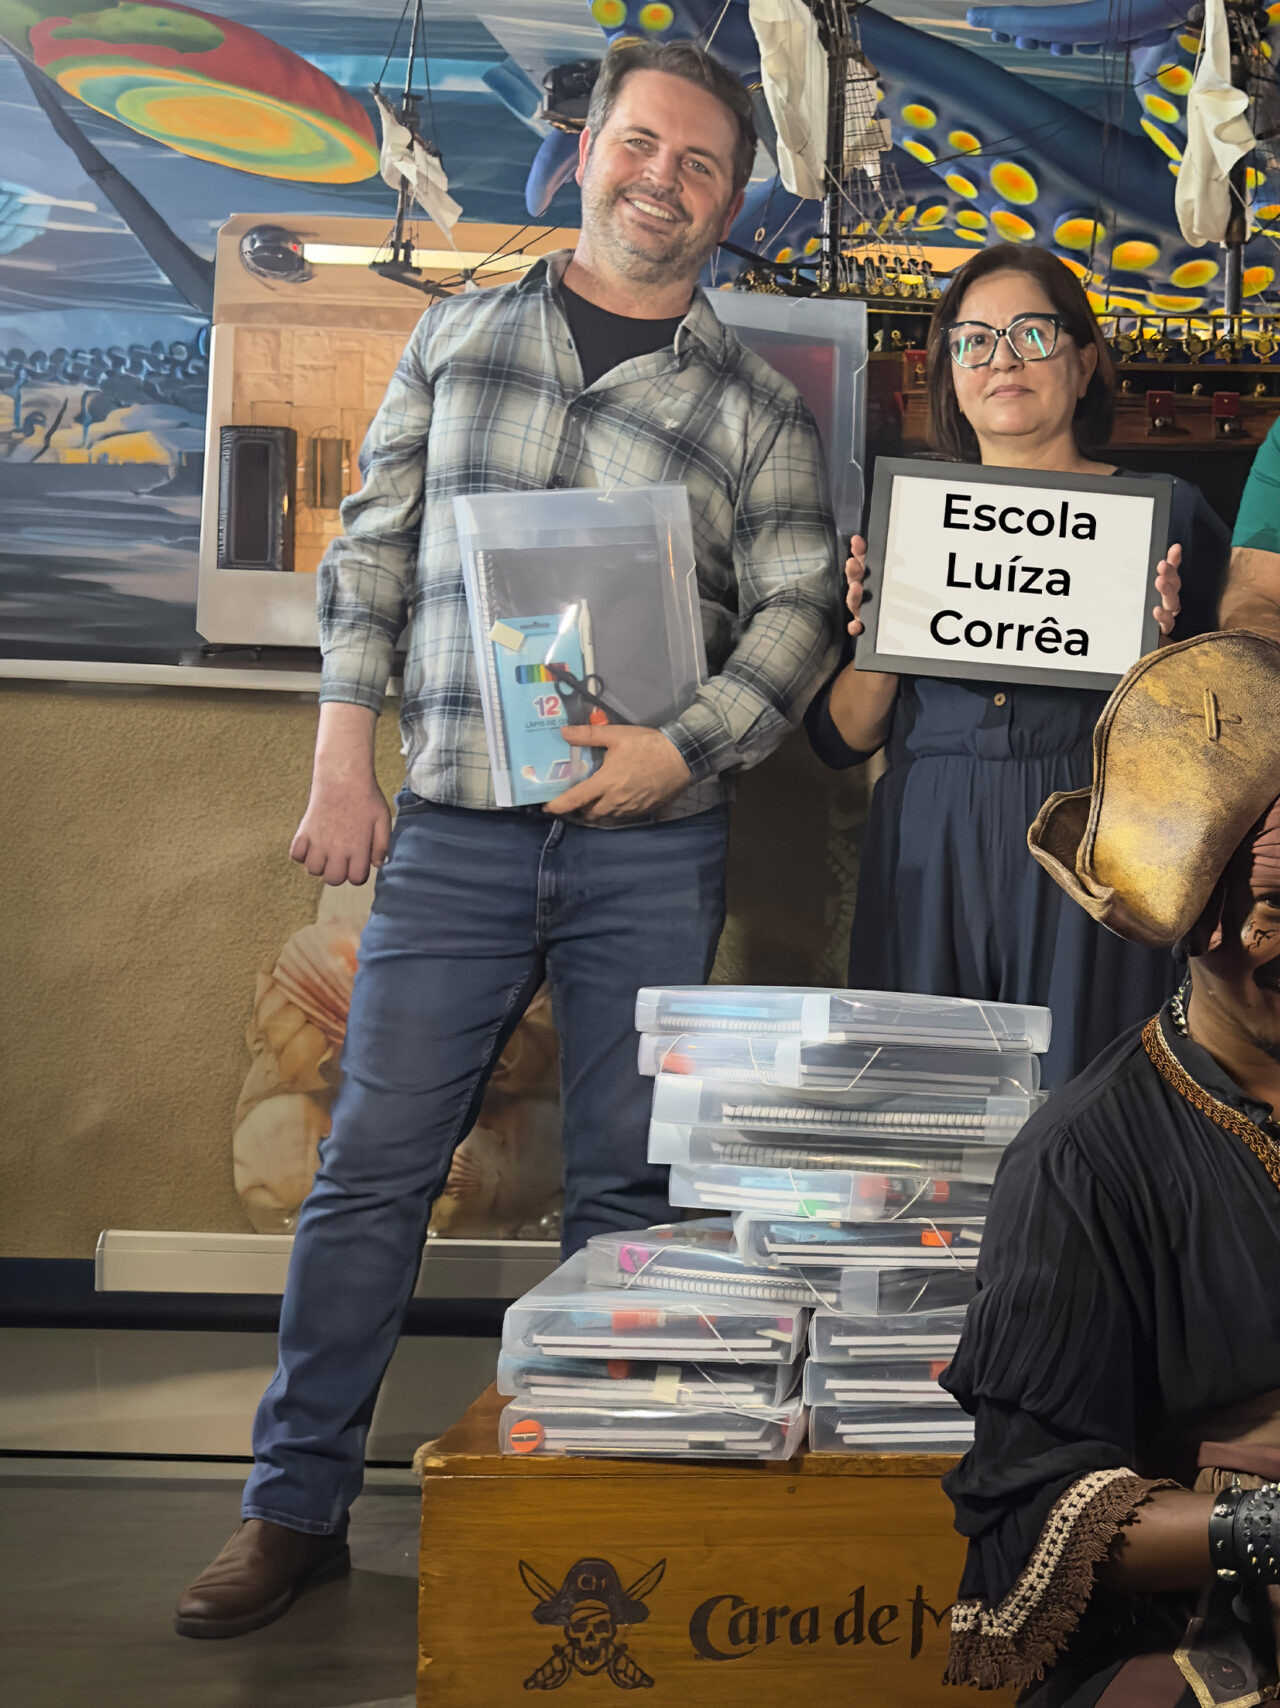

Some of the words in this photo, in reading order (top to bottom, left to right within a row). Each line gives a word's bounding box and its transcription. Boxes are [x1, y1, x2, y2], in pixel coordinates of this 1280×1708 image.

[943, 493, 1097, 541] Escola
[946, 552, 1071, 597] Luíza
[930, 609, 1089, 657] Corrêa
[533, 695, 561, 718] 12
[689, 1594, 821, 1661] Cara
[834, 1584, 900, 1646] de
